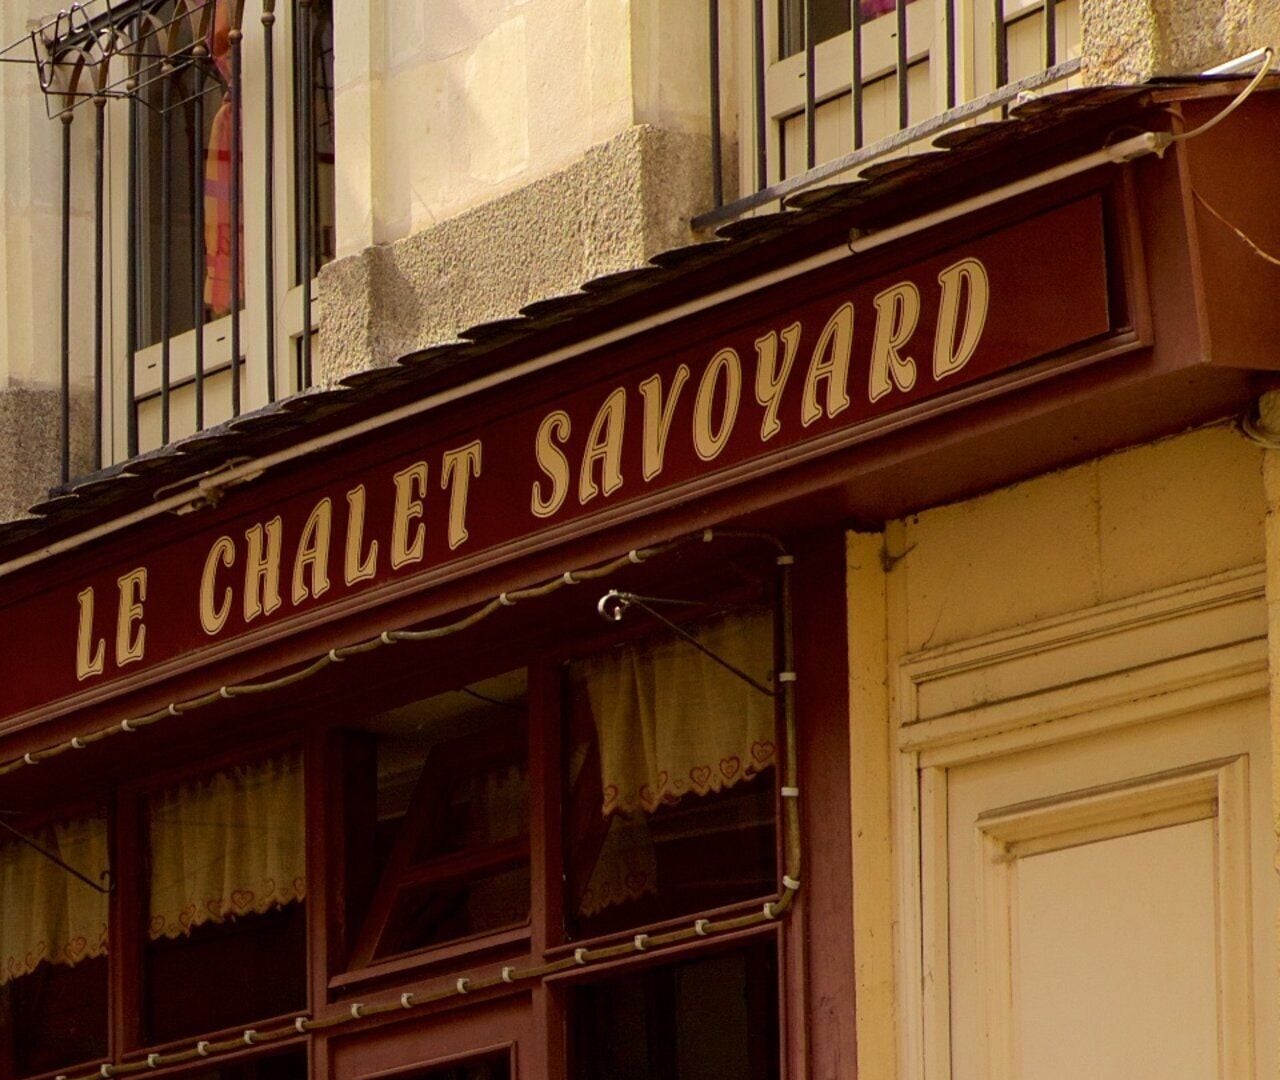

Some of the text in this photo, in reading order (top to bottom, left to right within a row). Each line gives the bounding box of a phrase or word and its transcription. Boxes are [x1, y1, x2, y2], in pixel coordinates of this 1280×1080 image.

[76, 566, 148, 681] LE
[199, 440, 482, 636] CHALET
[530, 256, 990, 518] SAVOYARD
